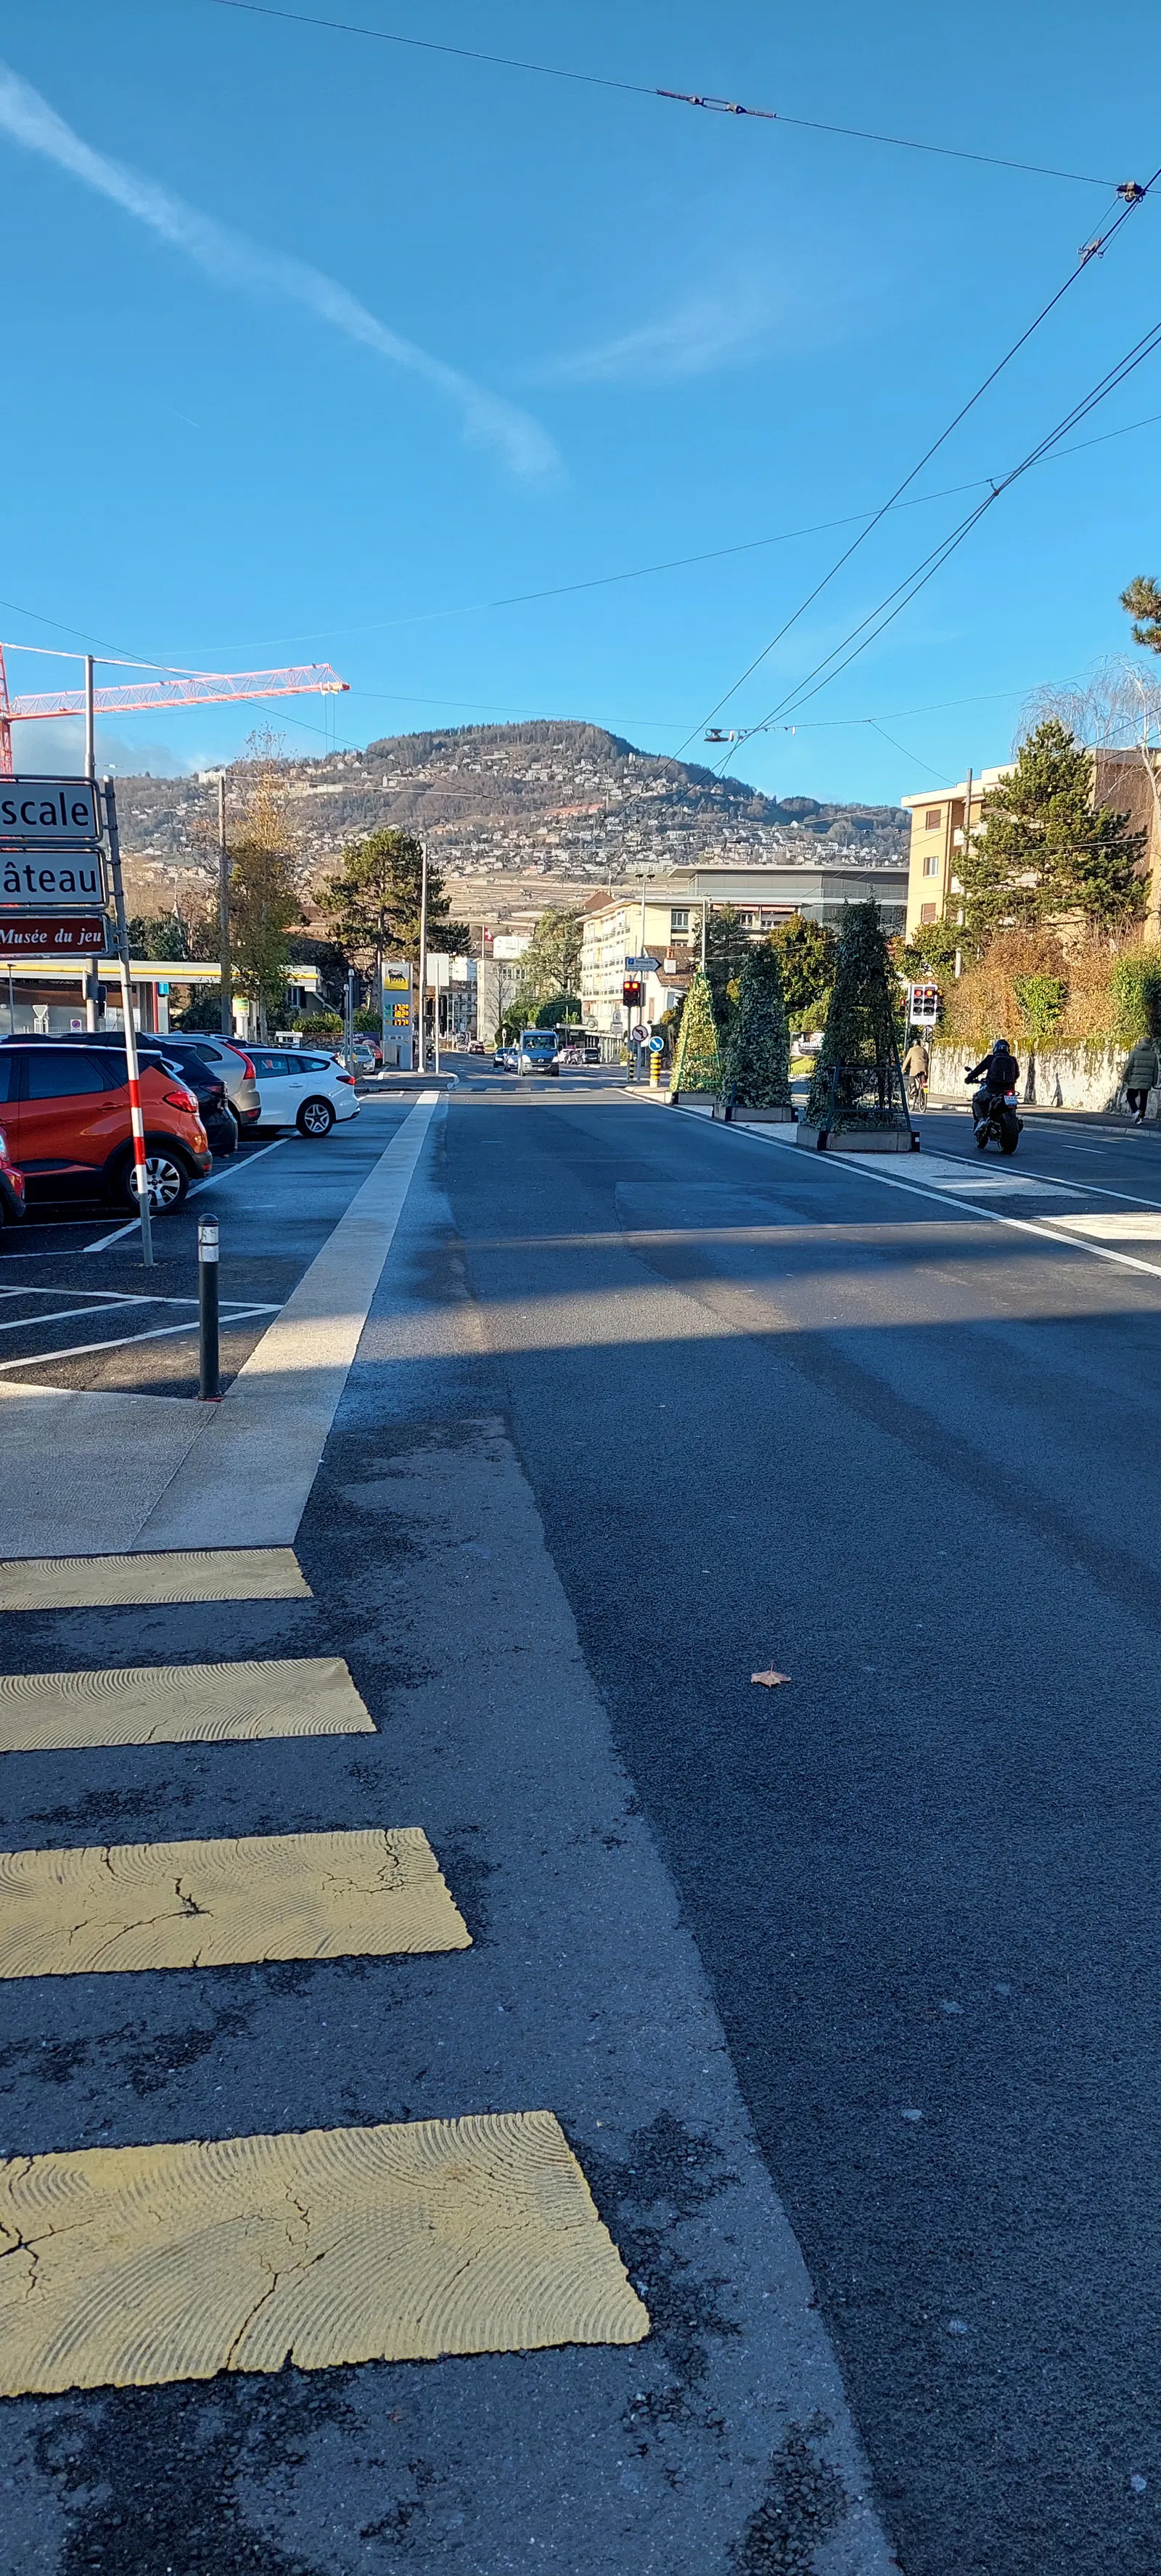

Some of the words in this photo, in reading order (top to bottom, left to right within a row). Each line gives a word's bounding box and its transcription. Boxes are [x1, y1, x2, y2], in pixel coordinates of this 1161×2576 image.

[1, 792, 89, 826] scale
[3, 861, 97, 893] âteau
[0, 929, 47, 943] Musée
[54, 928, 73, 943] du
[77, 928, 102, 945] jeu
